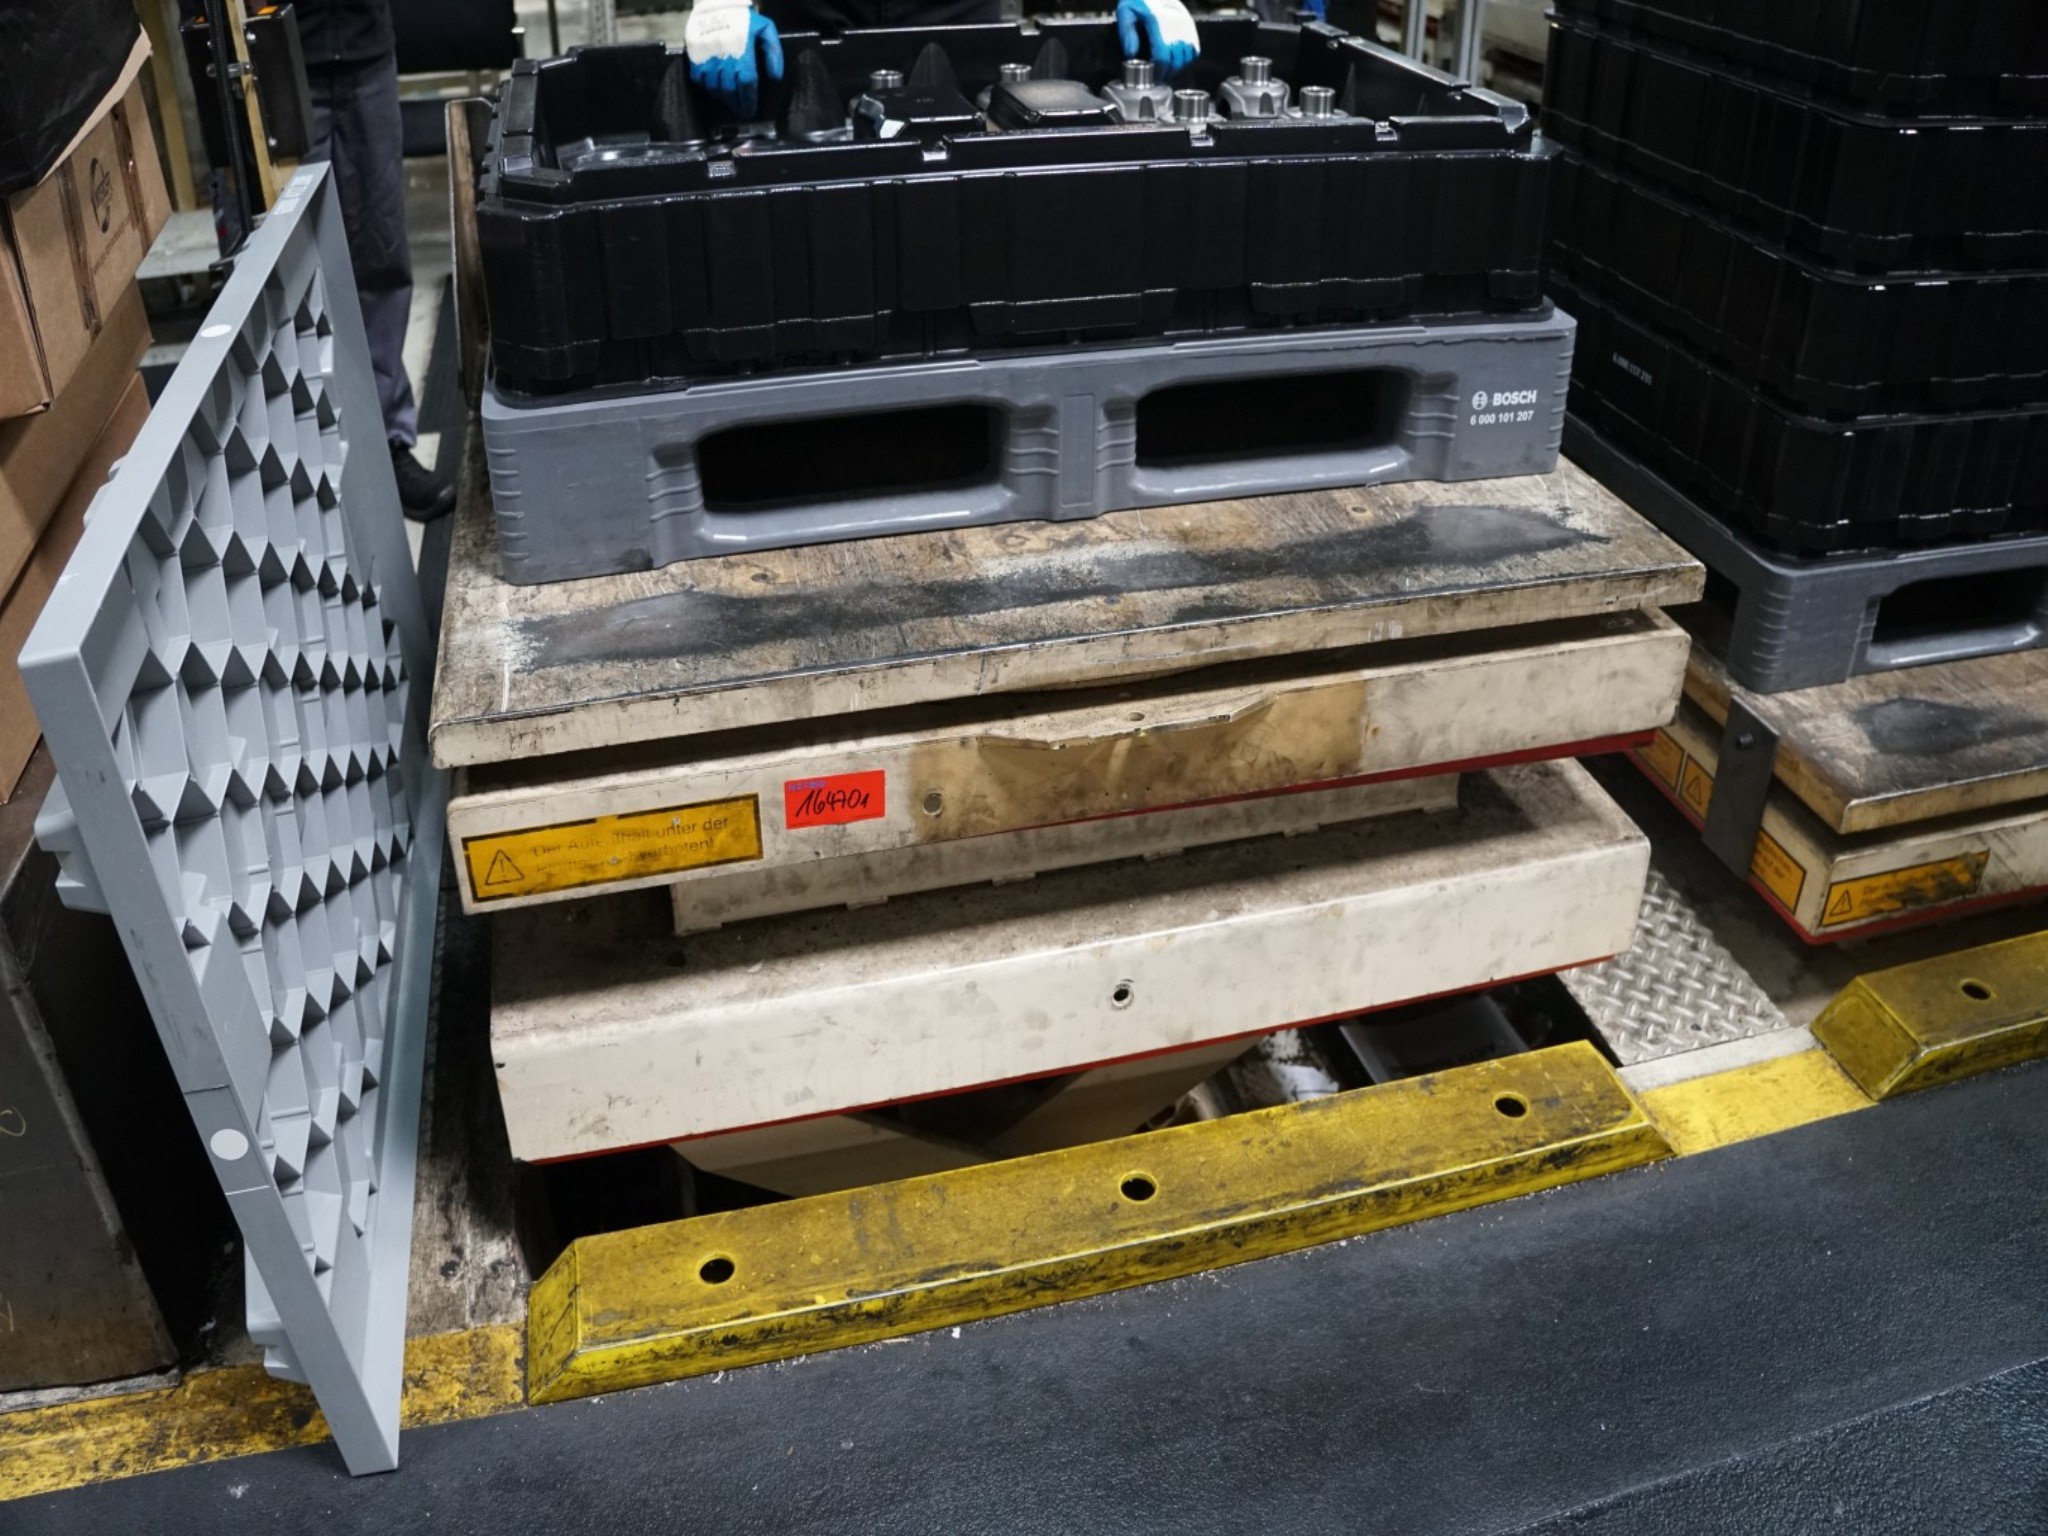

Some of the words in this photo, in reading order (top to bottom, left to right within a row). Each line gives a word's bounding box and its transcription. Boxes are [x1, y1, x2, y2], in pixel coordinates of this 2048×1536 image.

[1493, 389, 1537, 406] BOSCH
[1470, 414, 1477, 426] 6
[1478, 412, 1496, 425] 000
[1498, 411, 1514, 423] 101
[1516, 410, 1534, 422] 207
[655, 821, 698, 838] unter
[702, 816, 729, 832] der
